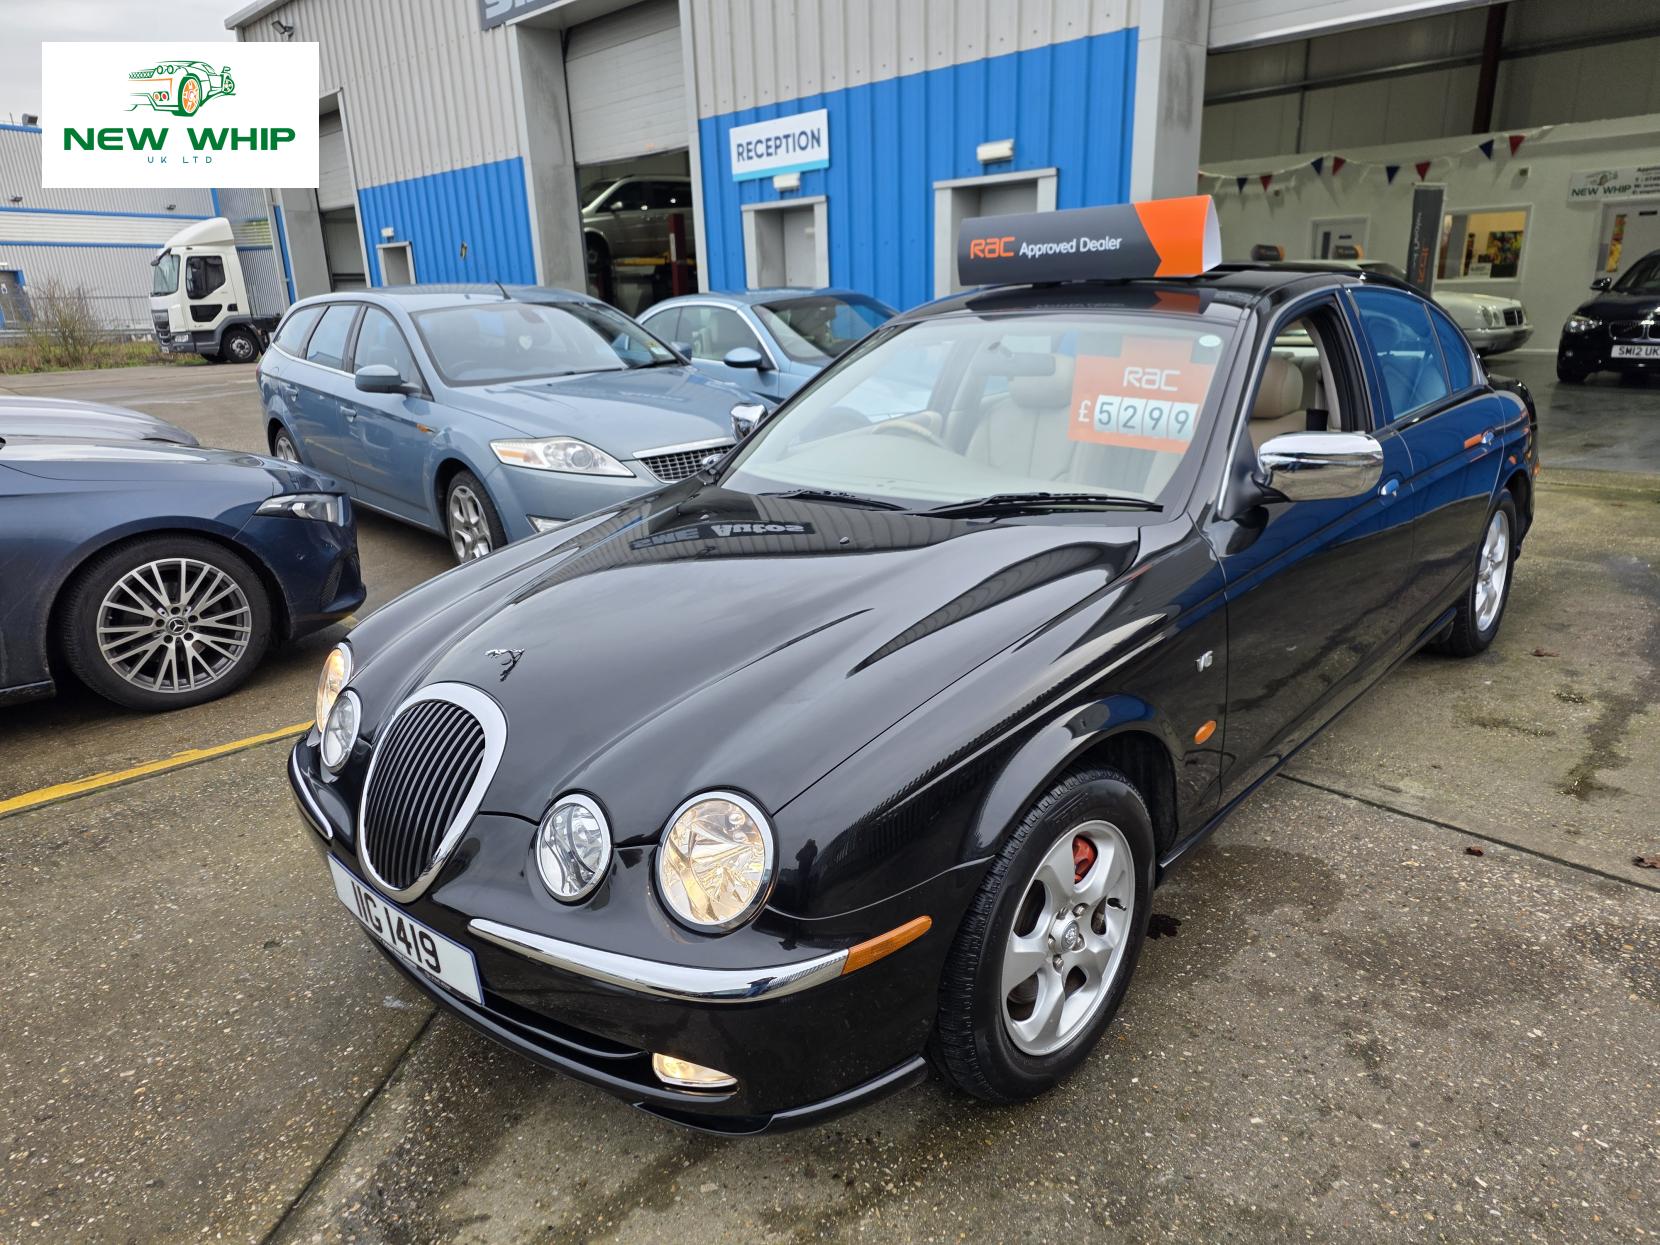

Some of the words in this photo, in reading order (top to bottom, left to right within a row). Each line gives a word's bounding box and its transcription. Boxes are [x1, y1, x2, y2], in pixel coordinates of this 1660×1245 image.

[736, 127, 821, 162] RECEPTION
[1571, 187, 1599, 197] NEW
[1603, 184, 1632, 195] WHIP
[1019, 239, 1077, 259] Approved
[1079, 235, 1123, 252] Dealer
